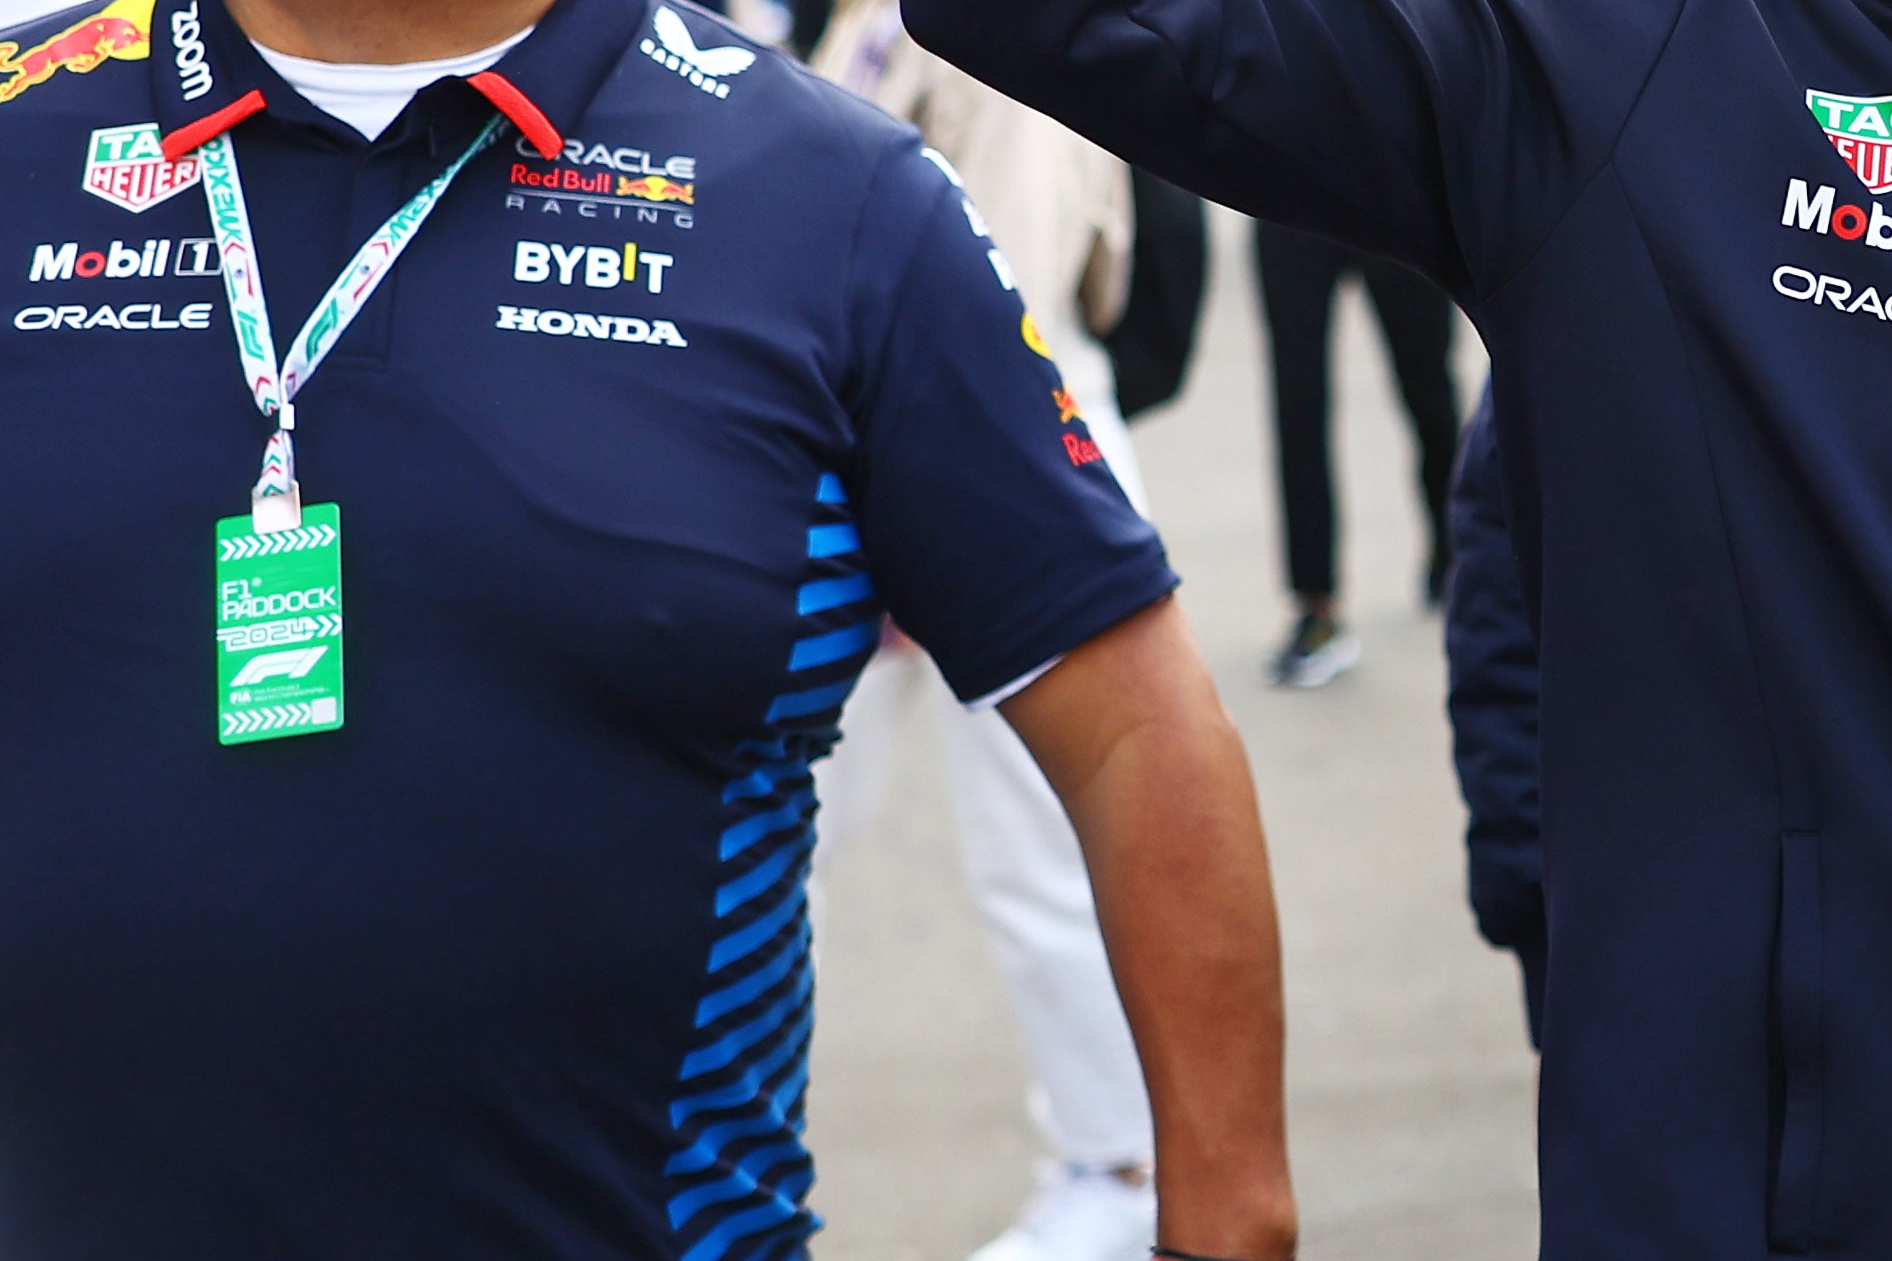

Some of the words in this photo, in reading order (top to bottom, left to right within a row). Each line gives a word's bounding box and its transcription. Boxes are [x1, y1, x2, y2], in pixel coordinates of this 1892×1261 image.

[171, 0, 214, 102] zoom
[100, 129, 165, 160] TA
[91, 158, 198, 207] HEUER
[510, 162, 560, 190] Red
[561, 169, 612, 194] Bull
[505, 193, 695, 230] RACING
[28, 239, 172, 282] Mobil
[513, 239, 674, 294] BYBIT
[13, 302, 214, 331] ORACLE
[495, 304, 689, 349] HONDA
[221, 586, 337, 621] PADDOCK
[229, 618, 310, 648] 2024
